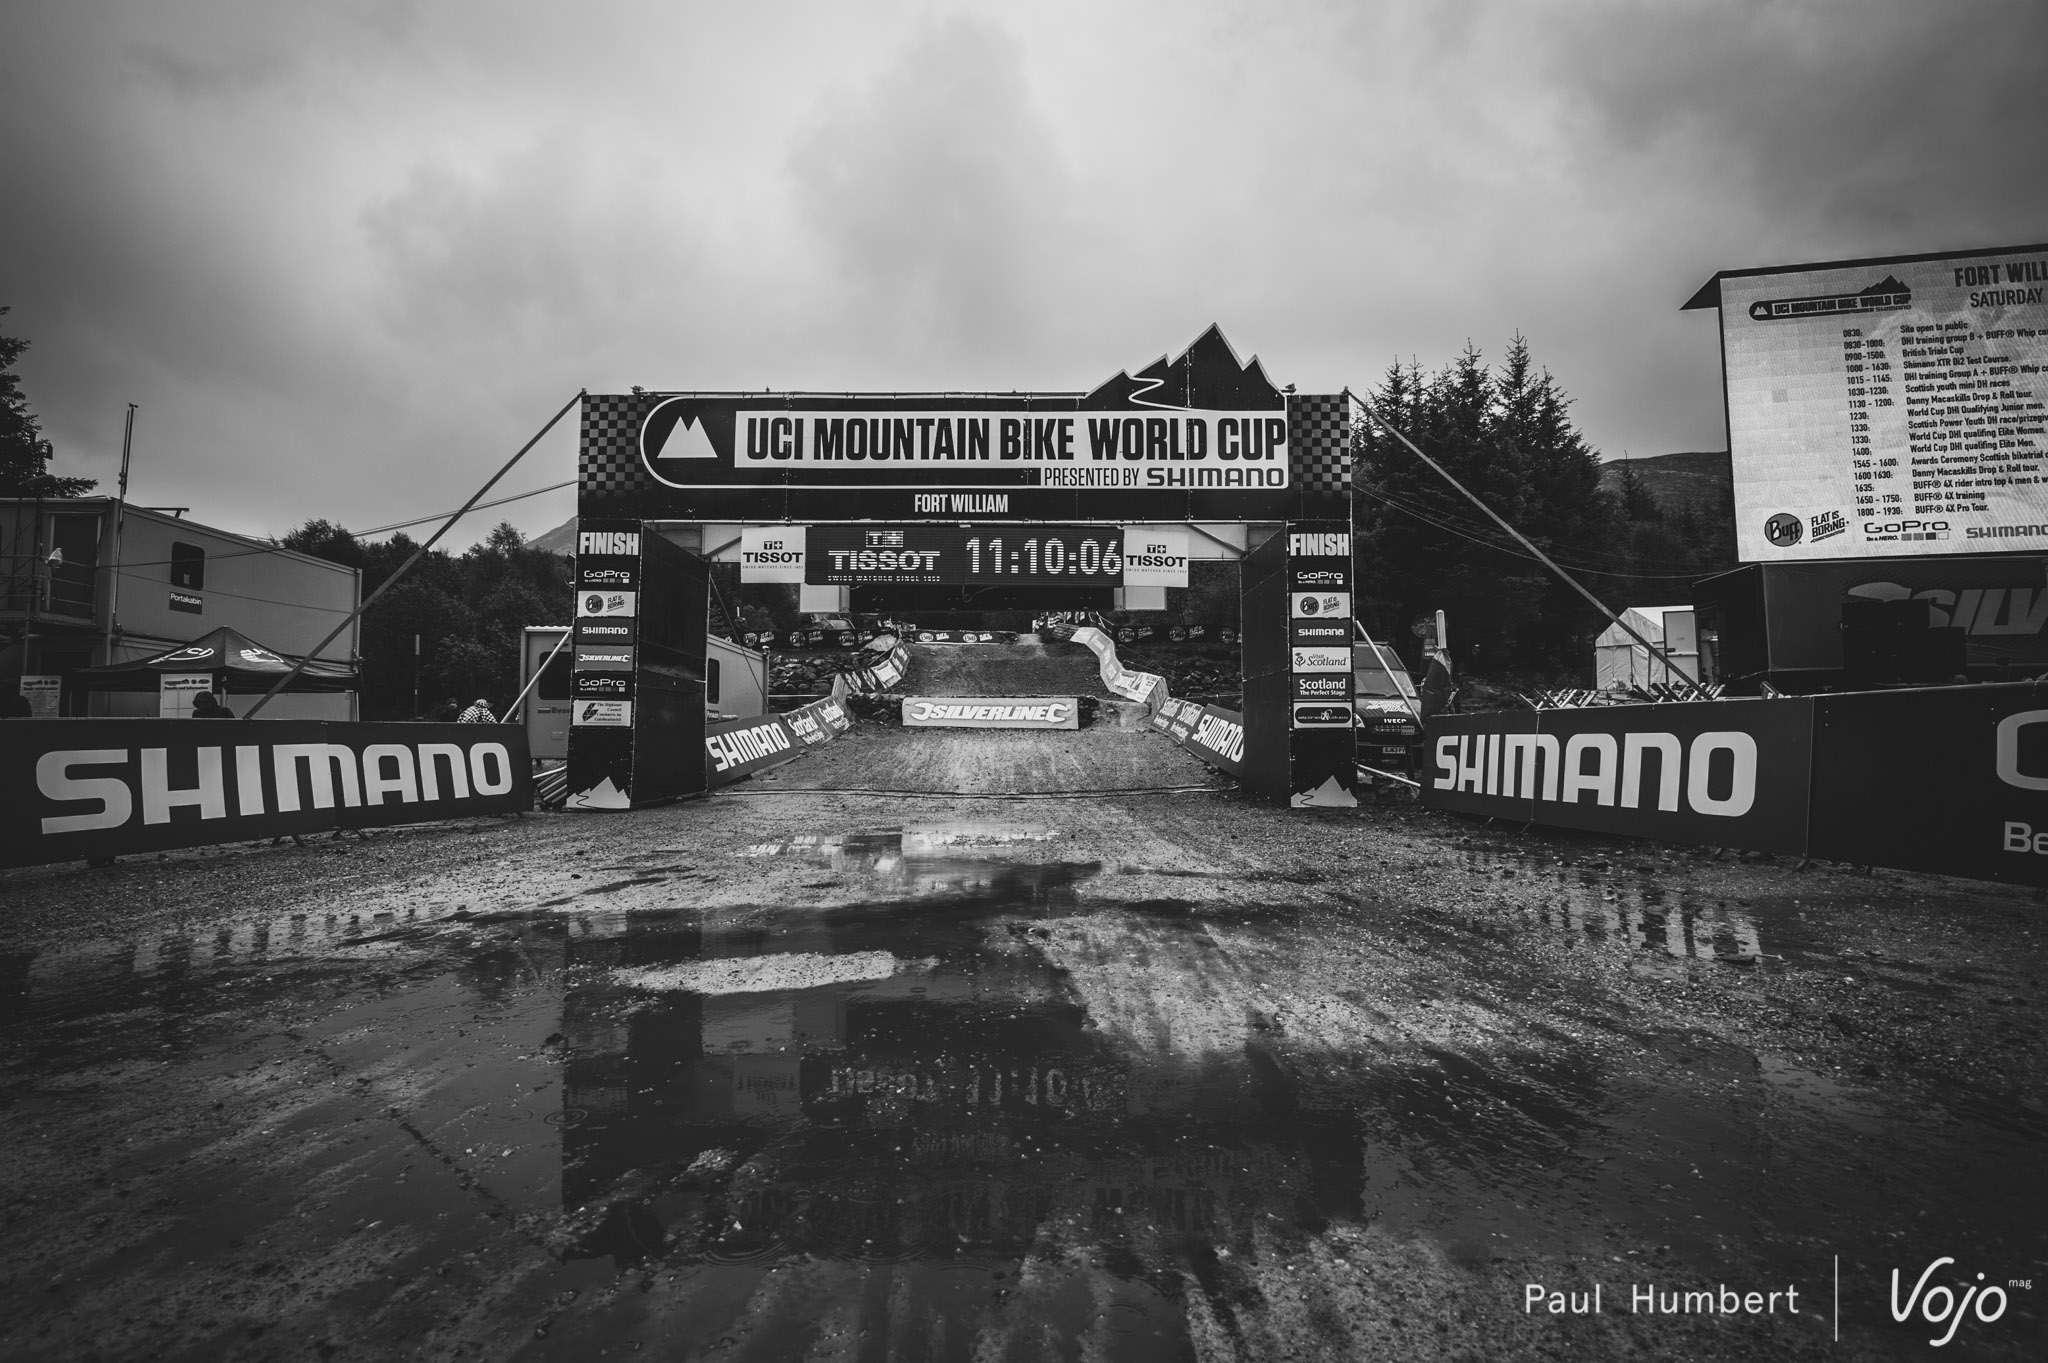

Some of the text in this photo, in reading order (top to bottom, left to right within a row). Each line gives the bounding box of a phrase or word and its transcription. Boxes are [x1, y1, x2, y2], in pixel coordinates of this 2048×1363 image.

[1955, 265, 2000, 287] FORT
[1774, 304, 1790, 314] UCI
[1791, 300, 1837, 313] MOUNTAIN
[1838, 298, 1858, 310] BIKE
[1860, 296, 1892, 308] WORLD
[1970, 288, 2043, 308] SATURDAY
[1900, 325, 1914, 334] Site
[1916, 325, 1934, 334] open
[1945, 320, 1968, 332] public
[1916, 335, 1944, 345] training
[1946, 335, 1968, 344] group
[1969, 332, 1975, 341] B
[2016, 328, 2036, 338] Whip
[1902, 348, 1927, 357] British
[1928, 347, 1948, 356] Trials
[1950, 346, 1964, 355] Cup
[1846, 365, 1864, 373] 1000
[1904, 360, 1936, 369] Shimano
[1937, 358, 1951, 367] XTR
[1953, 358, 1966, 366] Di2
[1966, 357, 1982, 365] Test
[1983, 356, 2012, 364] Course.
[1847, 376, 1864, 384] 1015
[1918, 371, 1948, 380] training
[1949, 370, 1971, 379] Group
[1973, 368, 1979, 376] A
[2020, 364, 2040, 374] Whip
[1905, 384, 1935, 393] Scottish
[1936, 382, 1957, 392] youth
[1959, 381, 1975, 390] mini
[1977, 380, 1988, 388] DH
[1990, 380, 2011, 388] races
[1849, 400, 1866, 408] 1130
[1906, 397, 1930, 406] Danny
[1931, 394, 1971, 404] Macaskills
[1972, 392, 1990, 402] Drop
[1992, 392, 1998, 400] &
[2000, 390, 2015, 400] Roll
[1907, 408, 1929, 417] World
[1930, 408, 1945, 417] Cup
[1961, 404, 1999, 414] Qualifying
[2001, 402, 2024, 412] Junior
[1851, 424, 1870, 432] 1330:
[1908, 420, 1938, 429] Scottish
[1940, 419, 1963, 427] Power
[1964, 417, 1985, 426] Youth
[1987, 416, 1998, 425] DH
[748, 417, 1286, 461] UCI MOUNTAIN BIKE WORLD CUP
[1852, 436, 1871, 444] 1330:
[1909, 432, 1931, 441] World
[1932, 432, 1947, 441] Cup
[1998, 427, 2014, 436] Elite
[2016, 427, 2046, 435] Women.
[1852, 448, 1872, 456] 1400:
[1910, 444, 1932, 453] World
[1933, 444, 1948, 453] Cup
[1999, 440, 2016, 448] Elite
[2017, 439, 2036, 447] Men.
[1853, 460, 1871, 468] 1545
[1911, 457, 1939, 466] Awards
[1941, 456, 1978, 464] Ceremony
[1980, 452, 2010, 462] Scottish
[2012, 450, 2044, 460] biketrial
[1044, 467, 1284, 487] PRESENTED BY SHIMANO
[1854, 472, 1872, 480] 1600
[1912, 469, 1935, 478] Danny
[1937, 466, 1977, 476] Macaskills
[1979, 466, 1997, 475] Drop
[2007, 464, 2021, 472] Roll
[2022, 464, 2040, 472] tour.
[1855, 484, 1875, 492] 1635:
[1943, 480, 1954, 488] 4X
[1955, 479, 1973, 487] rider
[1975, 478, 1992, 487] intro
[1994, 478, 2006, 487] top
[2034, 476, 2040, 484] &
[914, 494, 1009, 514] FORT WILLIAM
[1856, 496, 1874, 504] 1650
[1944, 492, 1954, 500] 4X
[1956, 490, 1985, 500] training
[1811, 510, 1840, 527] FLAT IS
[1857, 508, 1874, 517] 1800
[1946, 504, 1955, 512] 4X
[1957, 504, 1970, 512] Pro
[1971, 503, 1990, 512] Tour.
[580, 532, 640, 556] FINISH
[1290, 533, 1350, 556] FINISH
[743, 552, 804, 563] TISSOT
[828, 550, 941, 571] TISSOT
[966, 537, 1122, 575] 11:10:06
[1126, 555, 1187, 568] TISSOT
[584, 570, 630, 578] GoPro
[1297, 571, 1343, 580] GoPro
[170, 593, 202, 606] Portakabin
[582, 627, 628, 635] SHIMANO
[1298, 628, 1345, 636] SHIMANO
[1307, 656, 1347, 666] Scotland
[579, 679, 626, 687] GoPro
[1300, 678, 1346, 690] Scotland
[706, 722, 791, 772] SHIMANO
[1192, 714, 1244, 763] SHIMANO
[1434, 731, 1757, 818] SHIMANO
[36, 742, 513, 835] SHIMANO
